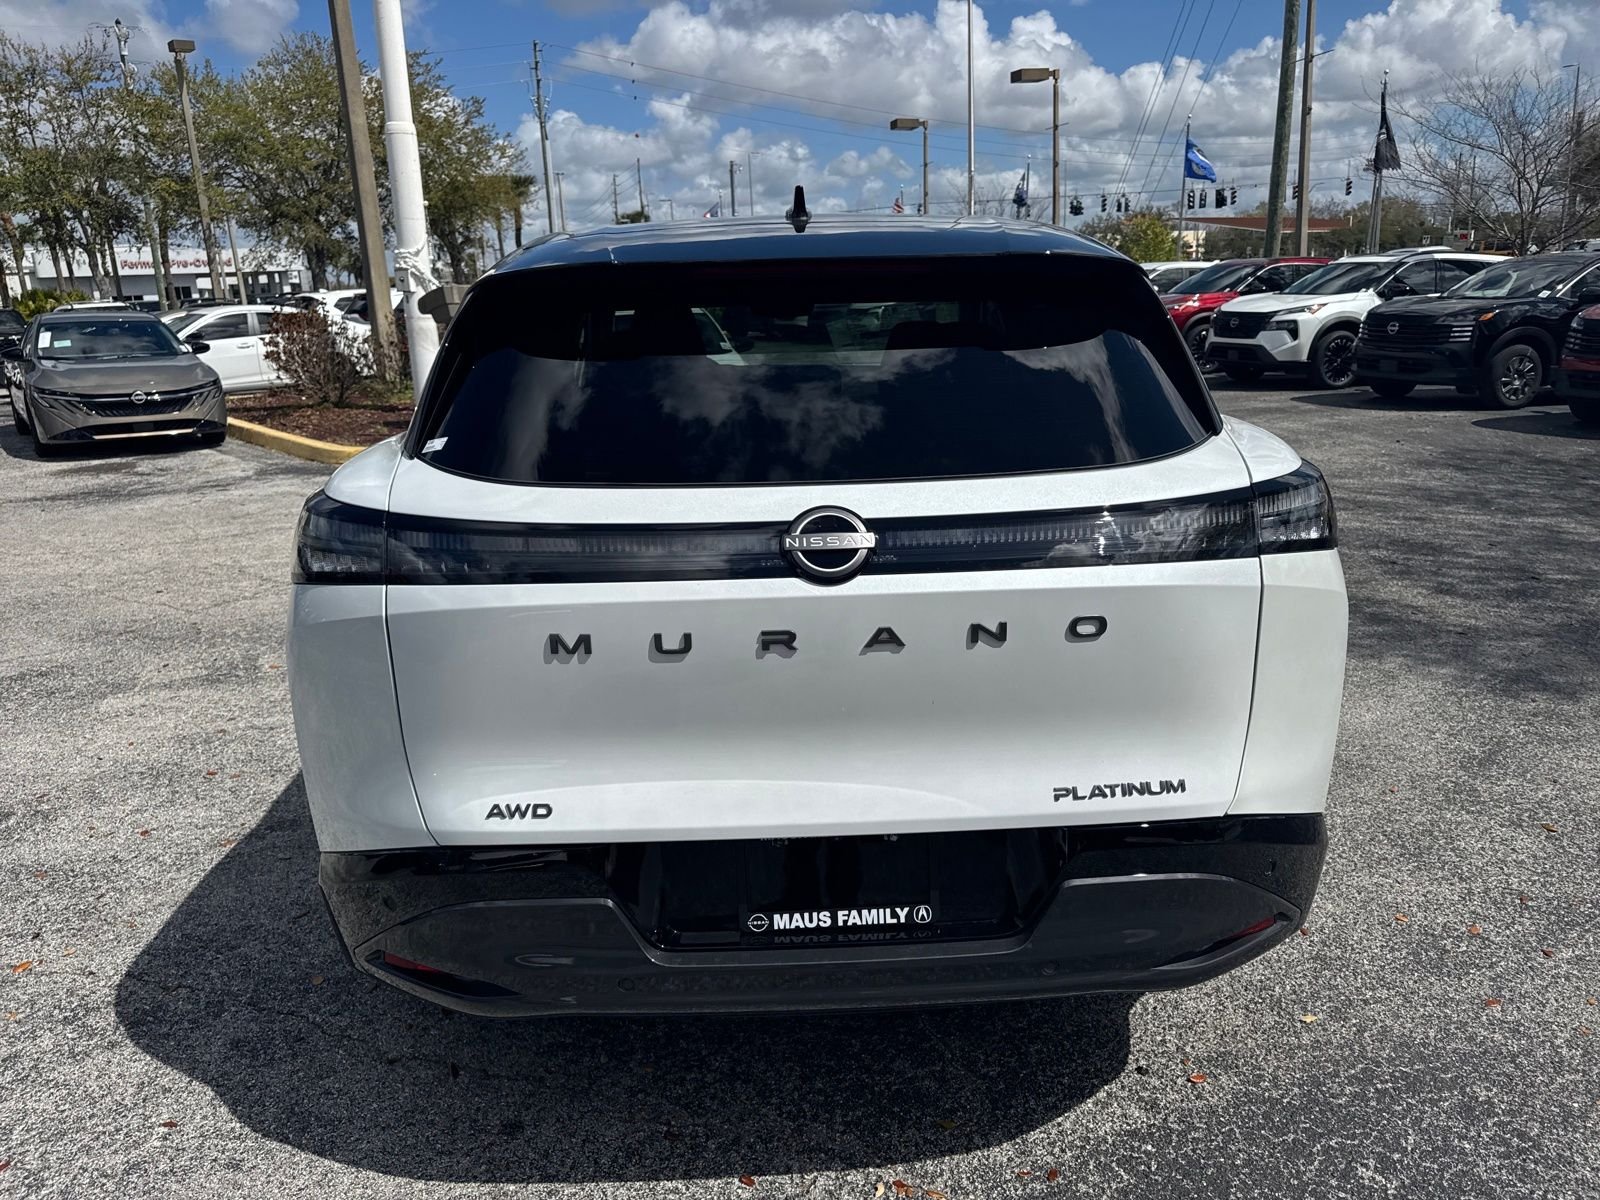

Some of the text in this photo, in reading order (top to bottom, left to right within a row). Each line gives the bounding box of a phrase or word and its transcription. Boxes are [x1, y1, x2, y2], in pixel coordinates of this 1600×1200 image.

[785, 533, 873, 548] NISSAN
[546, 615, 1108, 656] MURANO
[1053, 778, 1187, 802] PLATINUM
[484, 803, 553, 820] AWD
[773, 907, 910, 930] MAUS FAMILY
